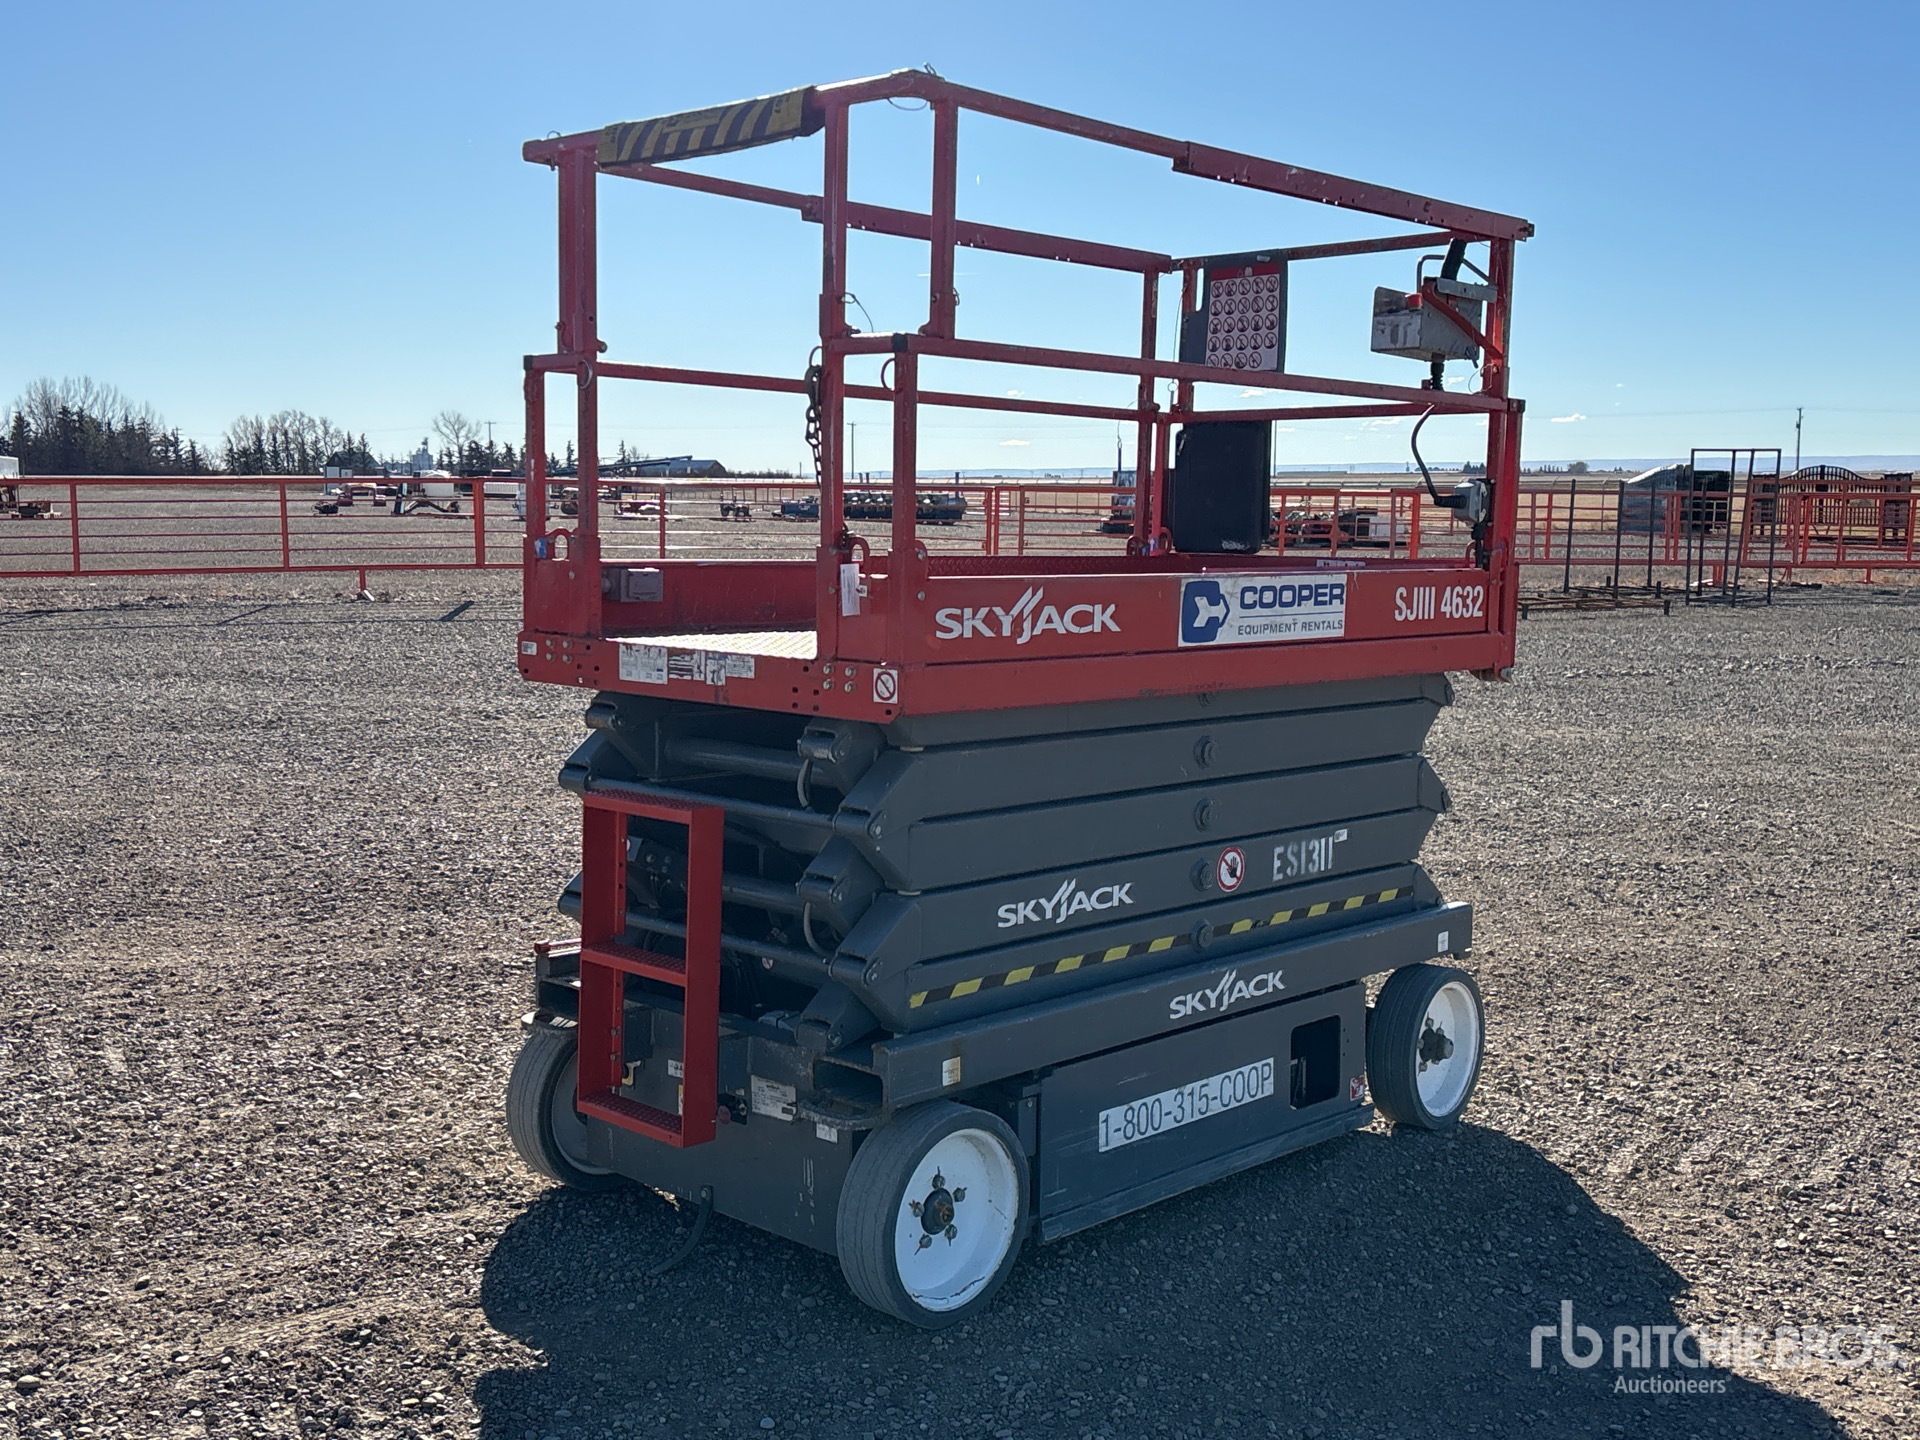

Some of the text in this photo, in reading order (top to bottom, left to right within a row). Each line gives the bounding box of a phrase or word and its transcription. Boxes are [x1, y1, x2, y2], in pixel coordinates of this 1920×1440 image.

[935, 586, 1121, 645] SKYJACK
[1240, 583, 1345, 610] COOPER
[1394, 585, 1484, 621] SJIII 4632
[1237, 619, 1344, 636] EQUIPMENT RENTALS
[997, 878, 1134, 928] SKYJACK
[1169, 969, 1286, 1020] SKYJACK
[1100, 1062, 1272, 1147] 1-800-315-COOP
